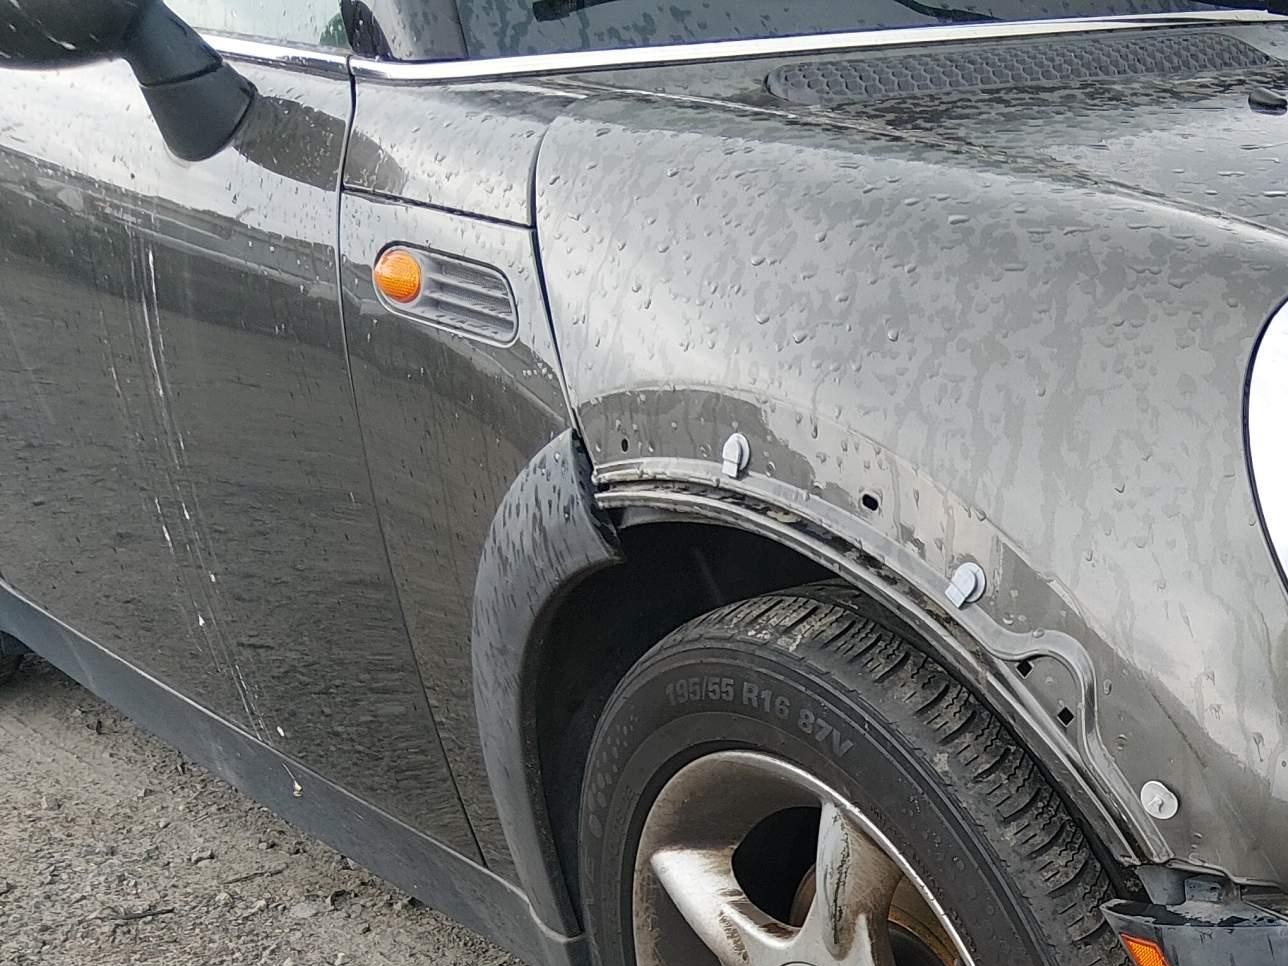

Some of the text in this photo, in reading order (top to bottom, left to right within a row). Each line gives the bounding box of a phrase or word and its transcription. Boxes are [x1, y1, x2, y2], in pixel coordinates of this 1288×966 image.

[665, 675, 855, 757] 195/55 R16 87V
